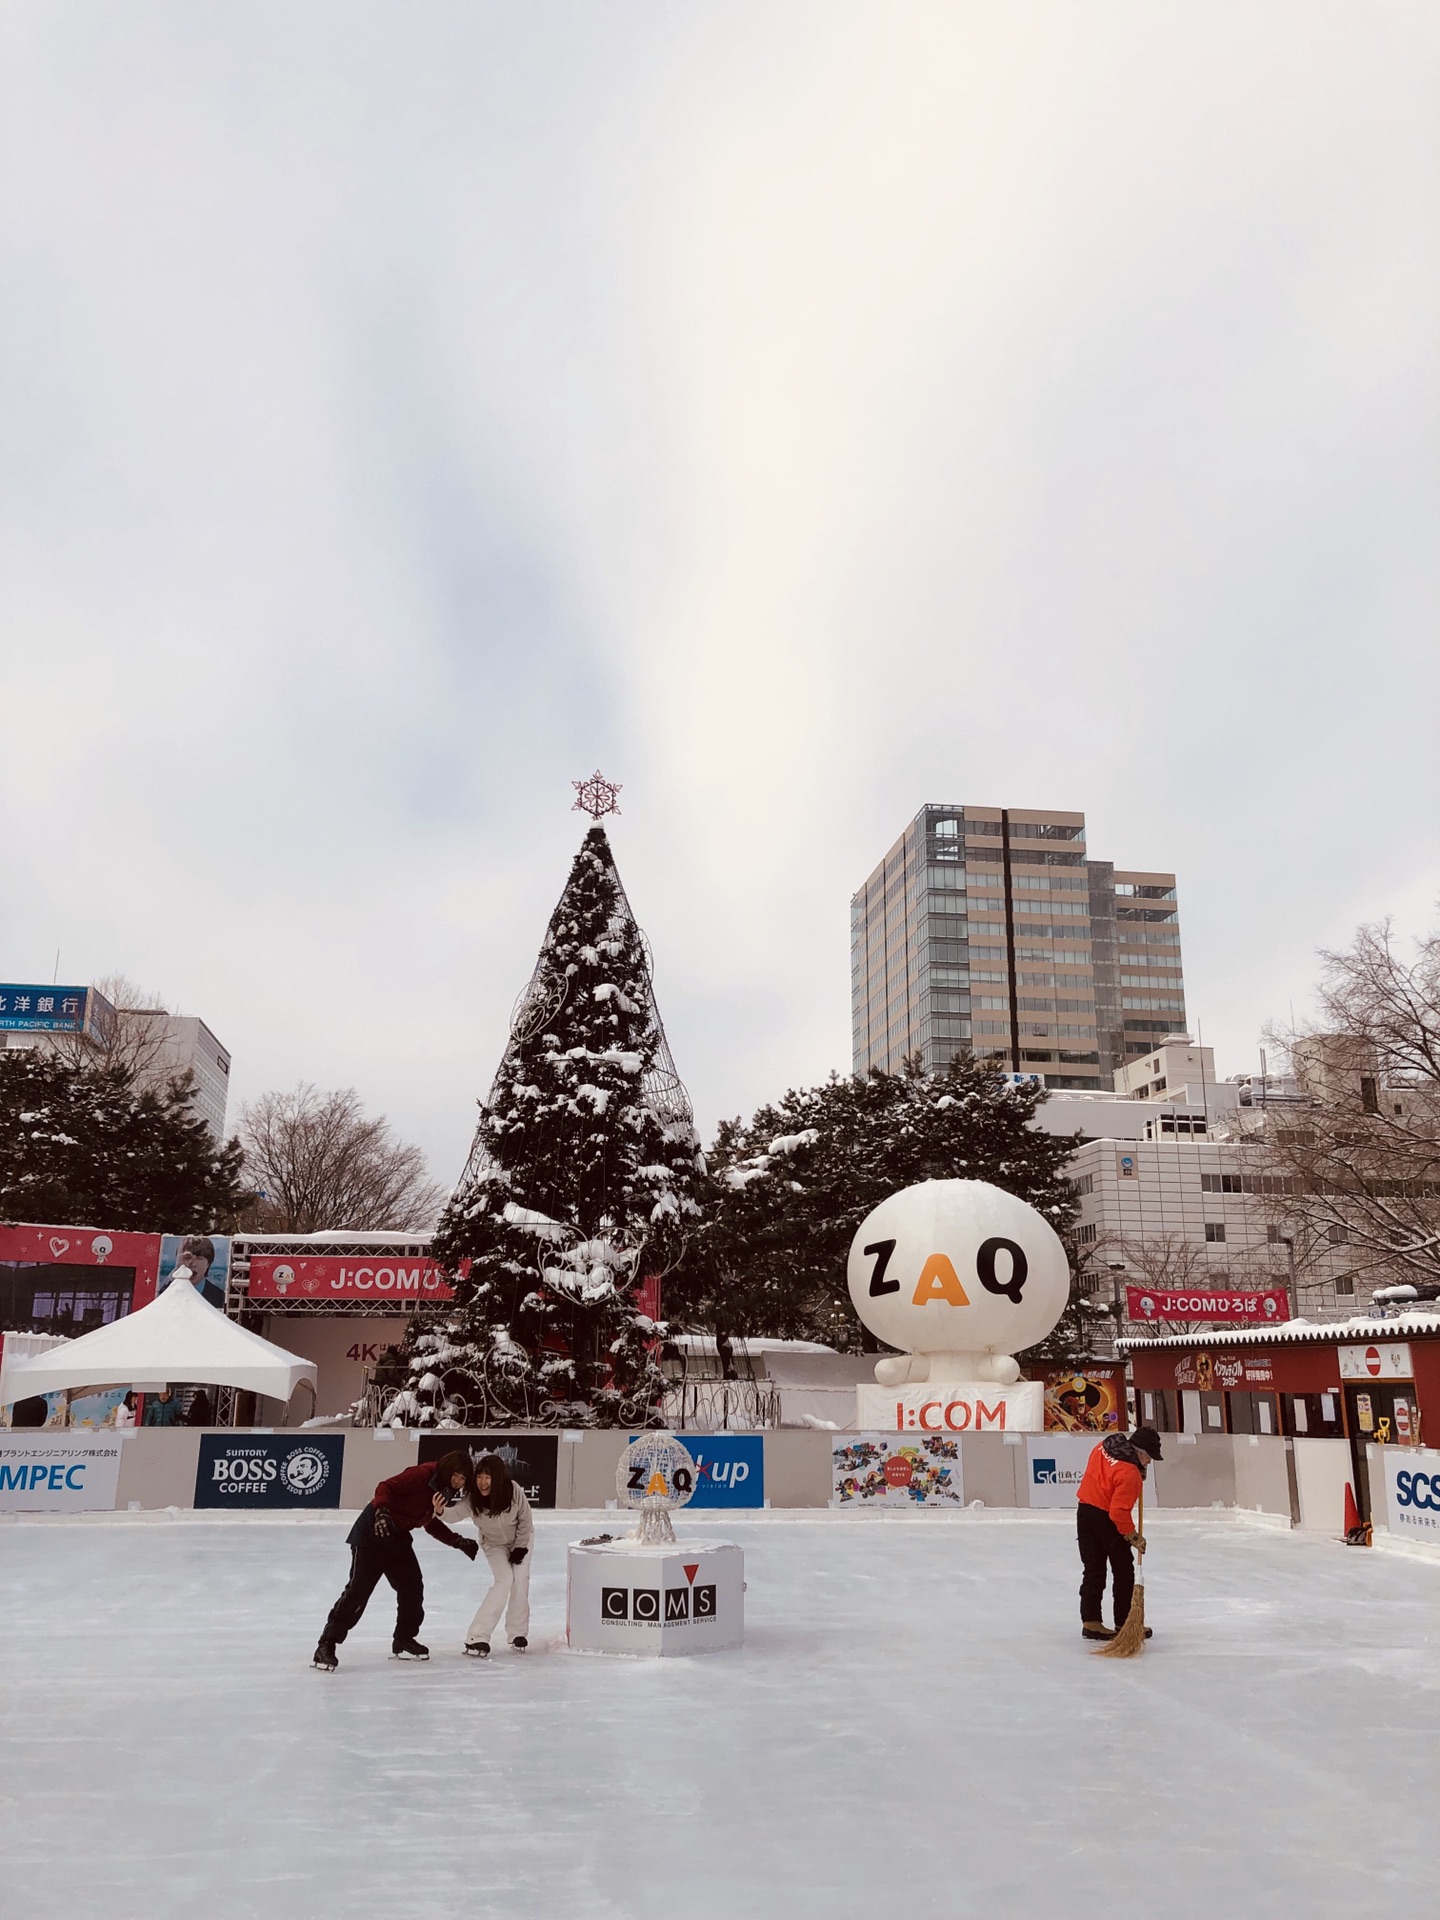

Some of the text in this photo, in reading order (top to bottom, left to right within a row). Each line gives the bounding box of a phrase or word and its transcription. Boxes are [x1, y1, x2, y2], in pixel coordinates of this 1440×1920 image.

[18, 1020, 50, 1028] PACIFIC
[863, 1236, 1028, 1307] ZAQ
[1162, 1296, 1258, 1313] J:COMひろば
[346, 1343, 379, 1361] 4K
[0, 1449, 118, 1458] プラントエンジニアリング株式会社
[225, 1449, 268, 1457] SUNTORY
[0, 1464, 87, 1491] MPEC
[211, 1459, 277, 1481] BOSS
[219, 1482, 267, 1493] COFFEE
[626, 1466, 692, 1496] ZAQ
[606, 1588, 711, 1618] COMS
[601, 1616, 717, 1629] CONSULTING MANAGEMENT SERVICE
